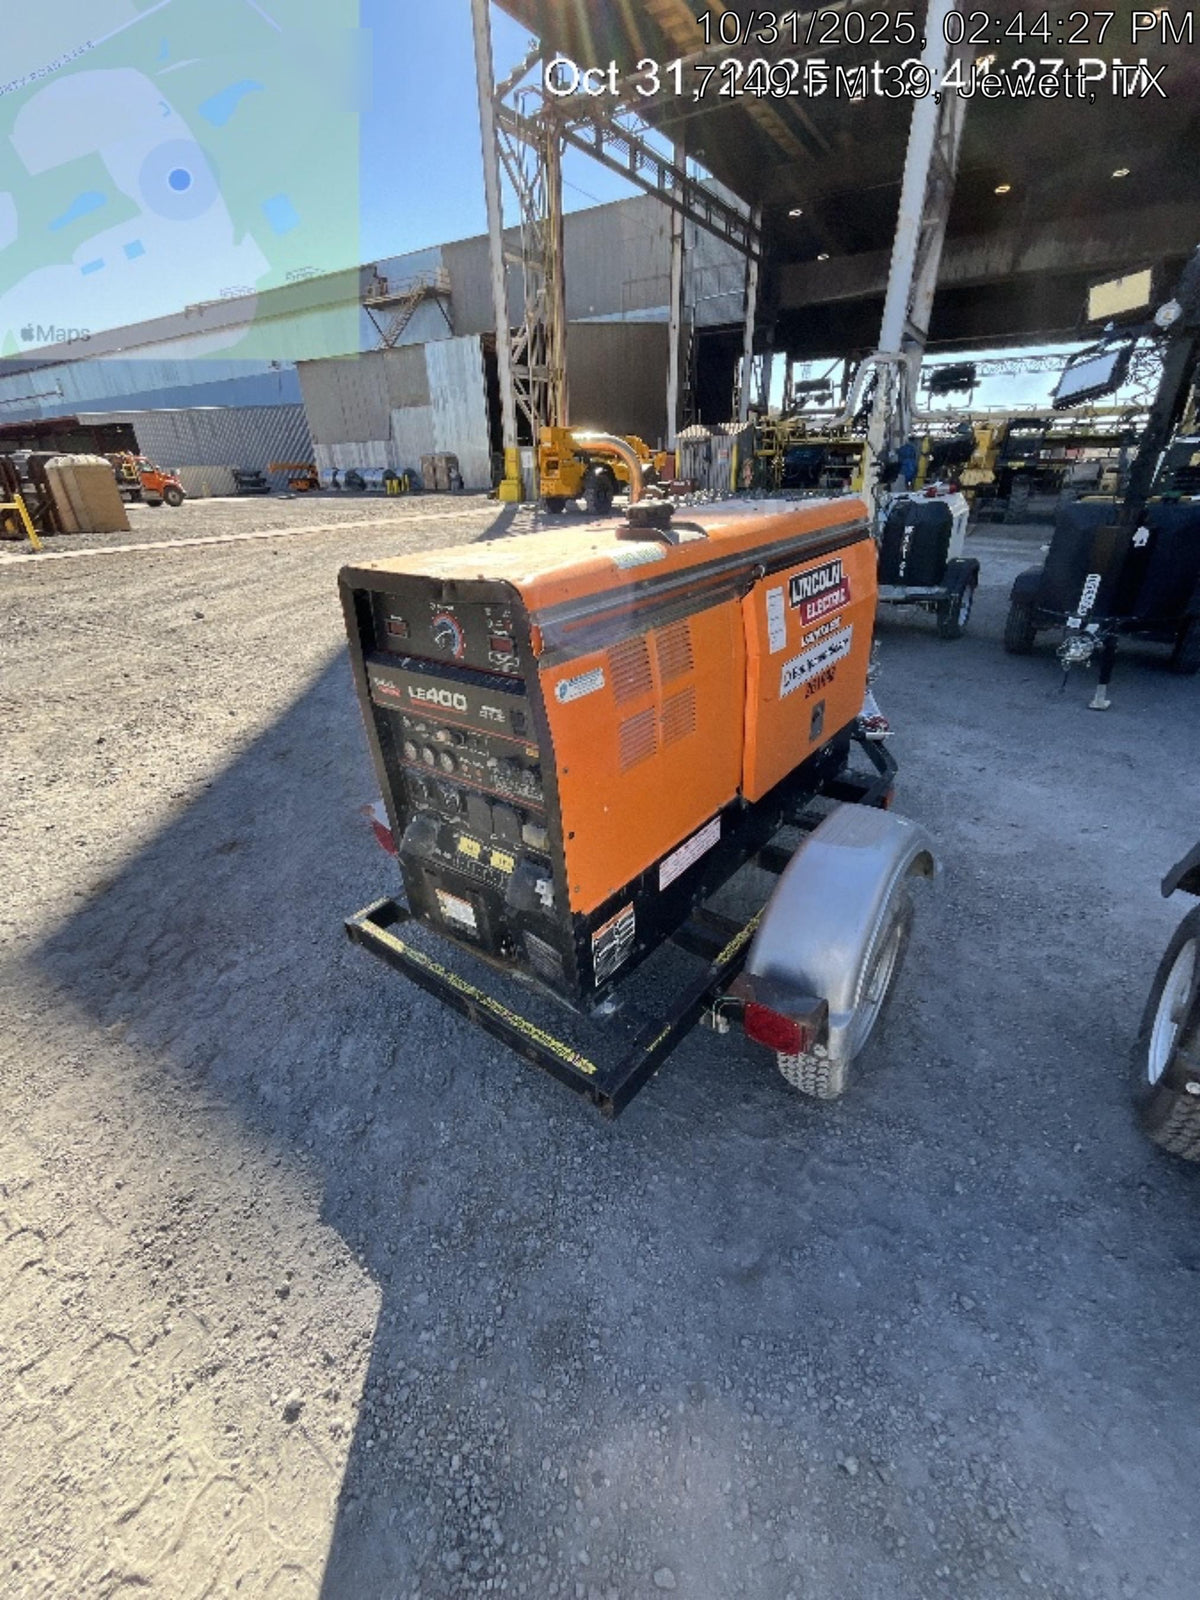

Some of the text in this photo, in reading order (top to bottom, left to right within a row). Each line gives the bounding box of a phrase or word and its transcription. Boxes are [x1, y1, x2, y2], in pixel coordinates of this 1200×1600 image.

[791, 563, 840, 603] LINCOLN
[806, 587, 846, 620] ELECTRIC
[408, 685, 468, 712] LE400
